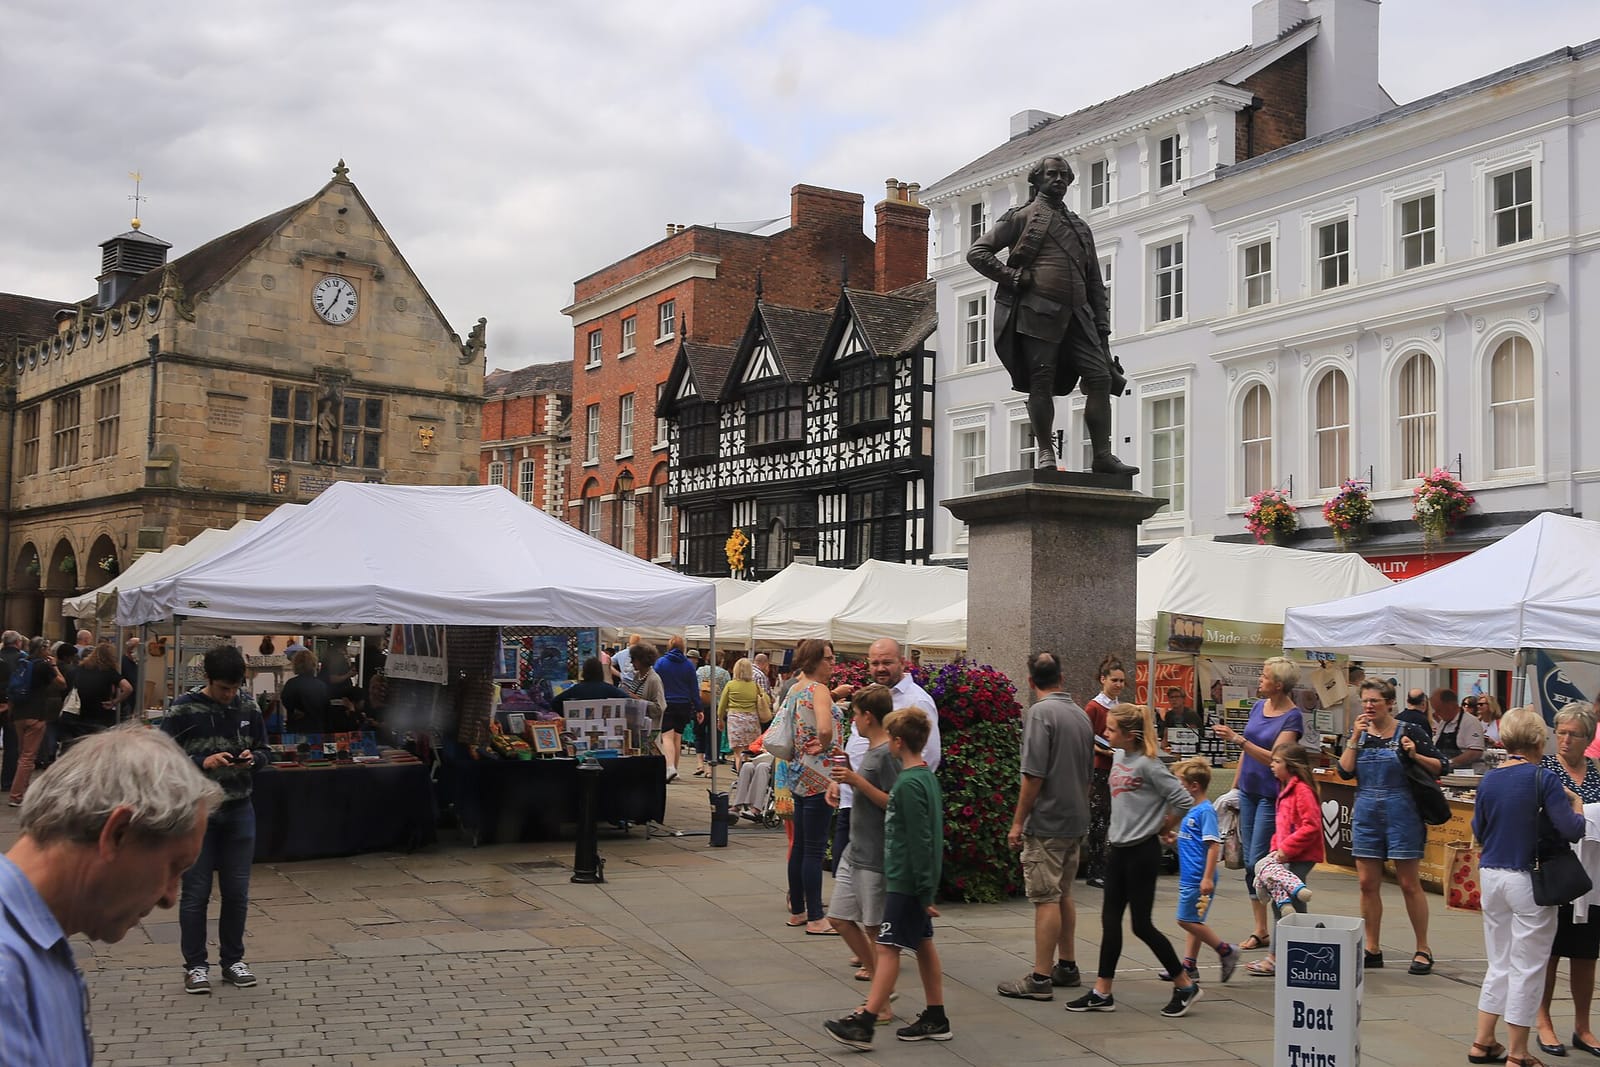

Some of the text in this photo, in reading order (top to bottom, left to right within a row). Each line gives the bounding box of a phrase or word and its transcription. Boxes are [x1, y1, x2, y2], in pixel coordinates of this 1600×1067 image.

[1206, 629, 1241, 644] Made
[1290, 967, 1337, 982] Sabrina
[1293, 1000, 1334, 1031] Boat
